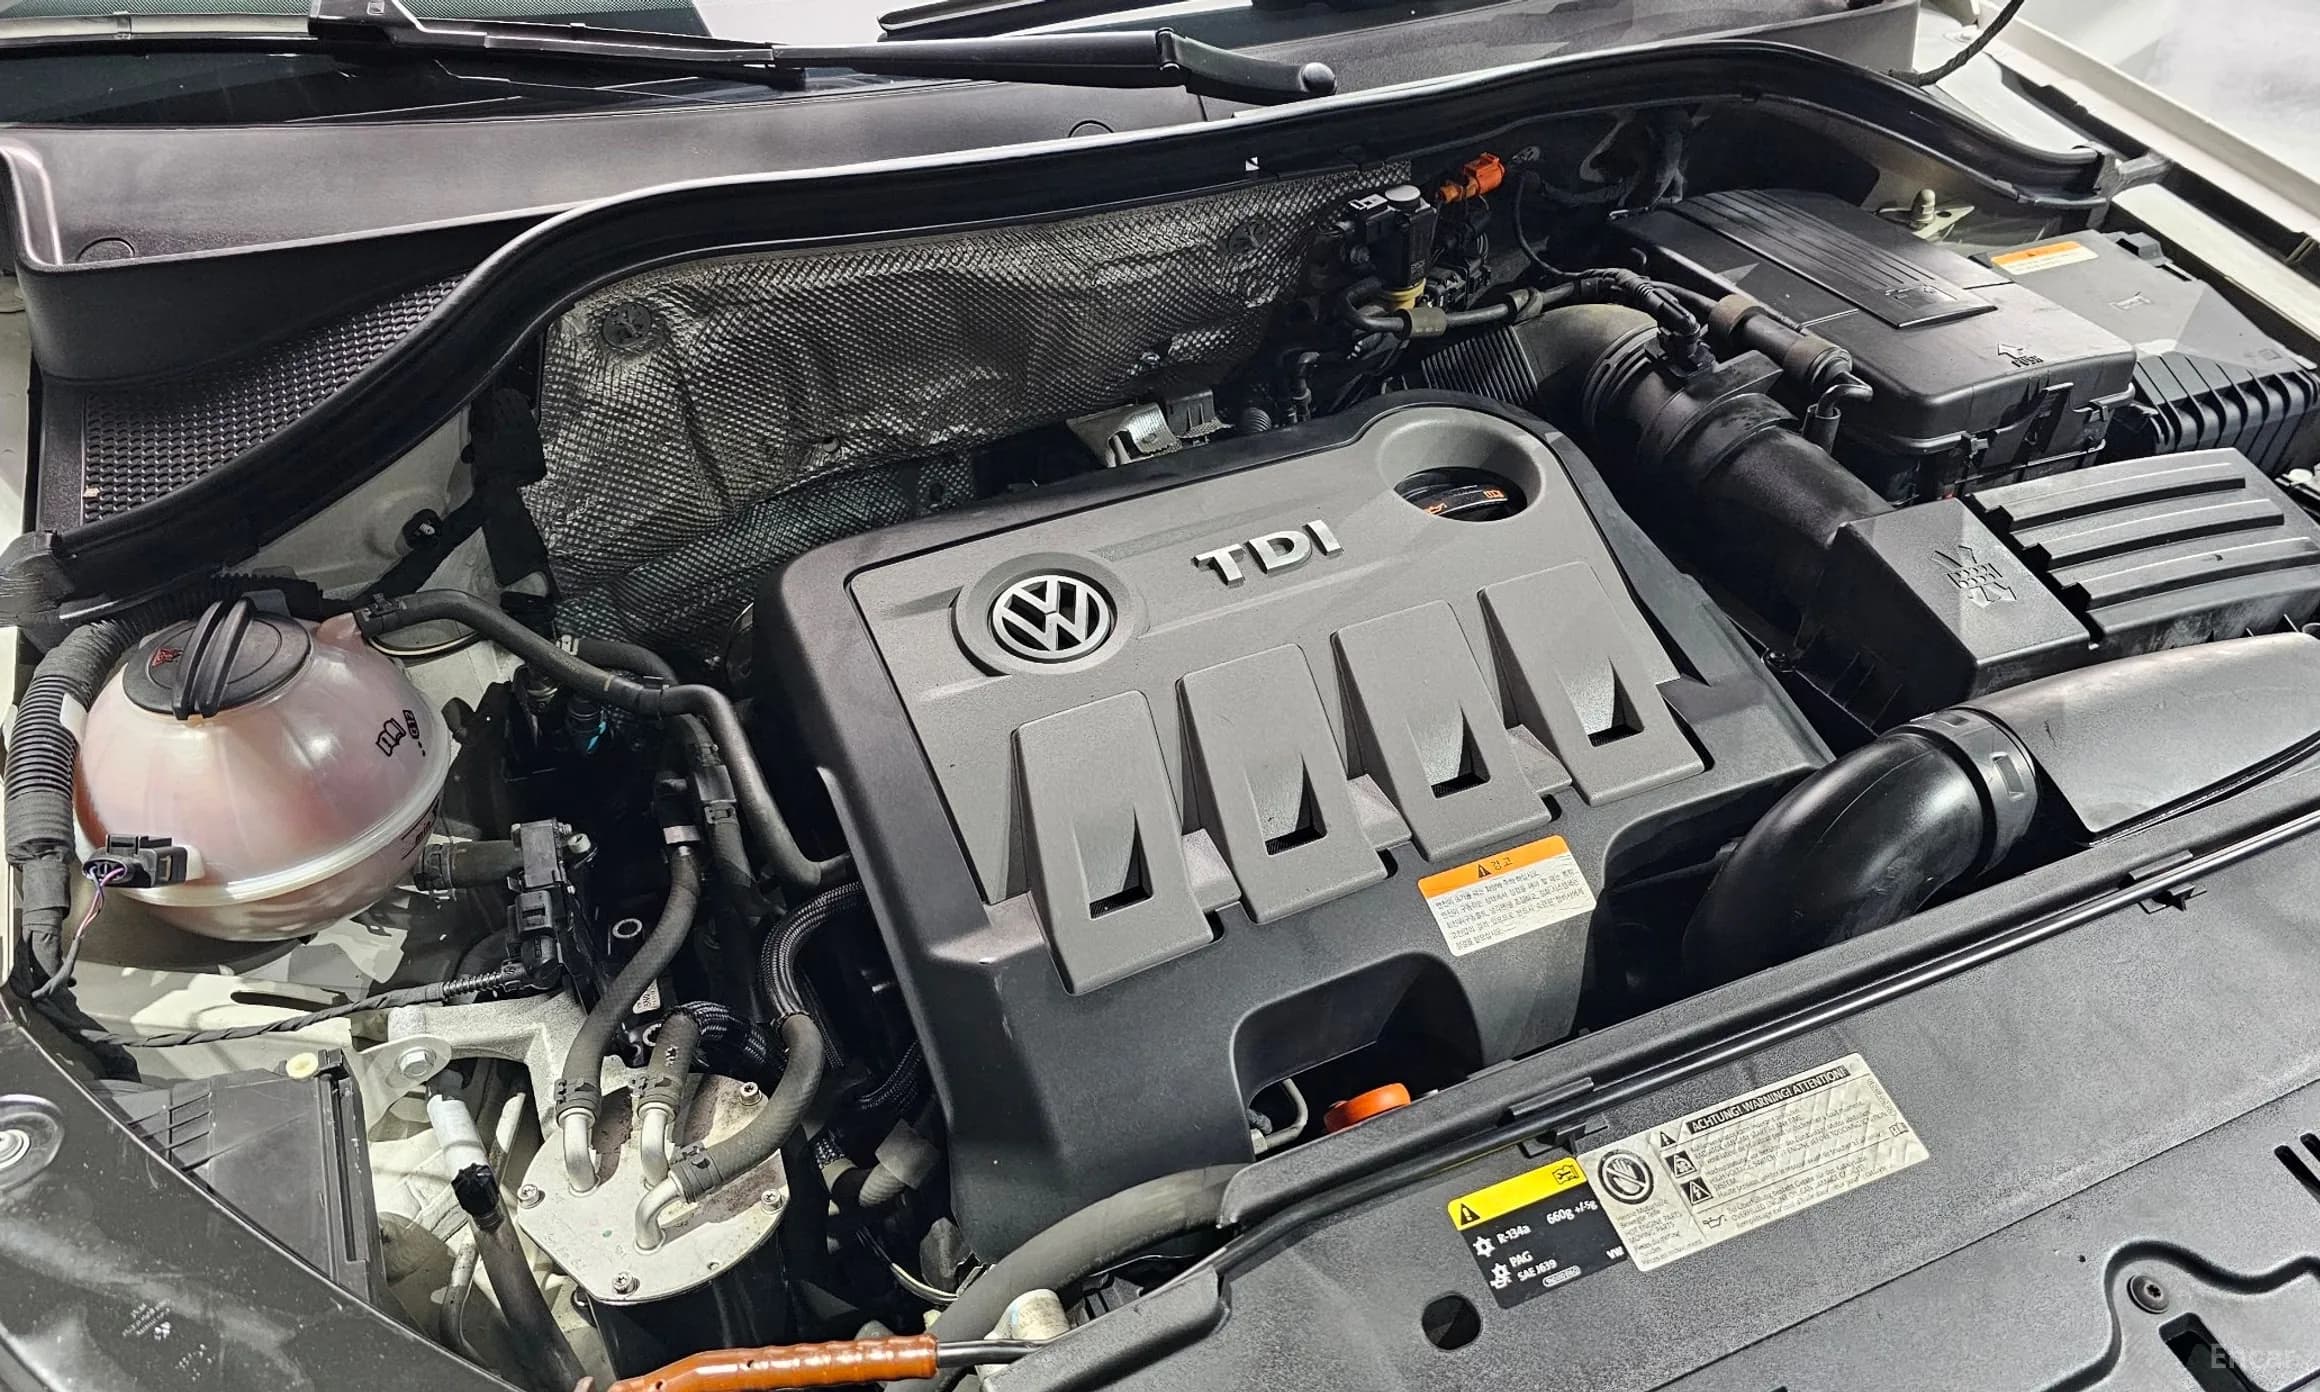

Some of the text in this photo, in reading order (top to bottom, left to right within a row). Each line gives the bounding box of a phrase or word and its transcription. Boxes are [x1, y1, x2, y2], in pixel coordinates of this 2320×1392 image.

[1194, 518, 1344, 588] TDI
[1691, 1066, 1849, 1131] ACHTUNG! WARNING! ATTENTION!
[1496, 1224, 1531, 1244] R-134a
[1546, 1208, 1575, 1226] 660g
[1507, 1250, 1534, 1267] PAG
[1605, 1245, 1625, 1259] VW
[1517, 1267, 1537, 1281] SAE
[1536, 1258, 1558, 1274] J639
